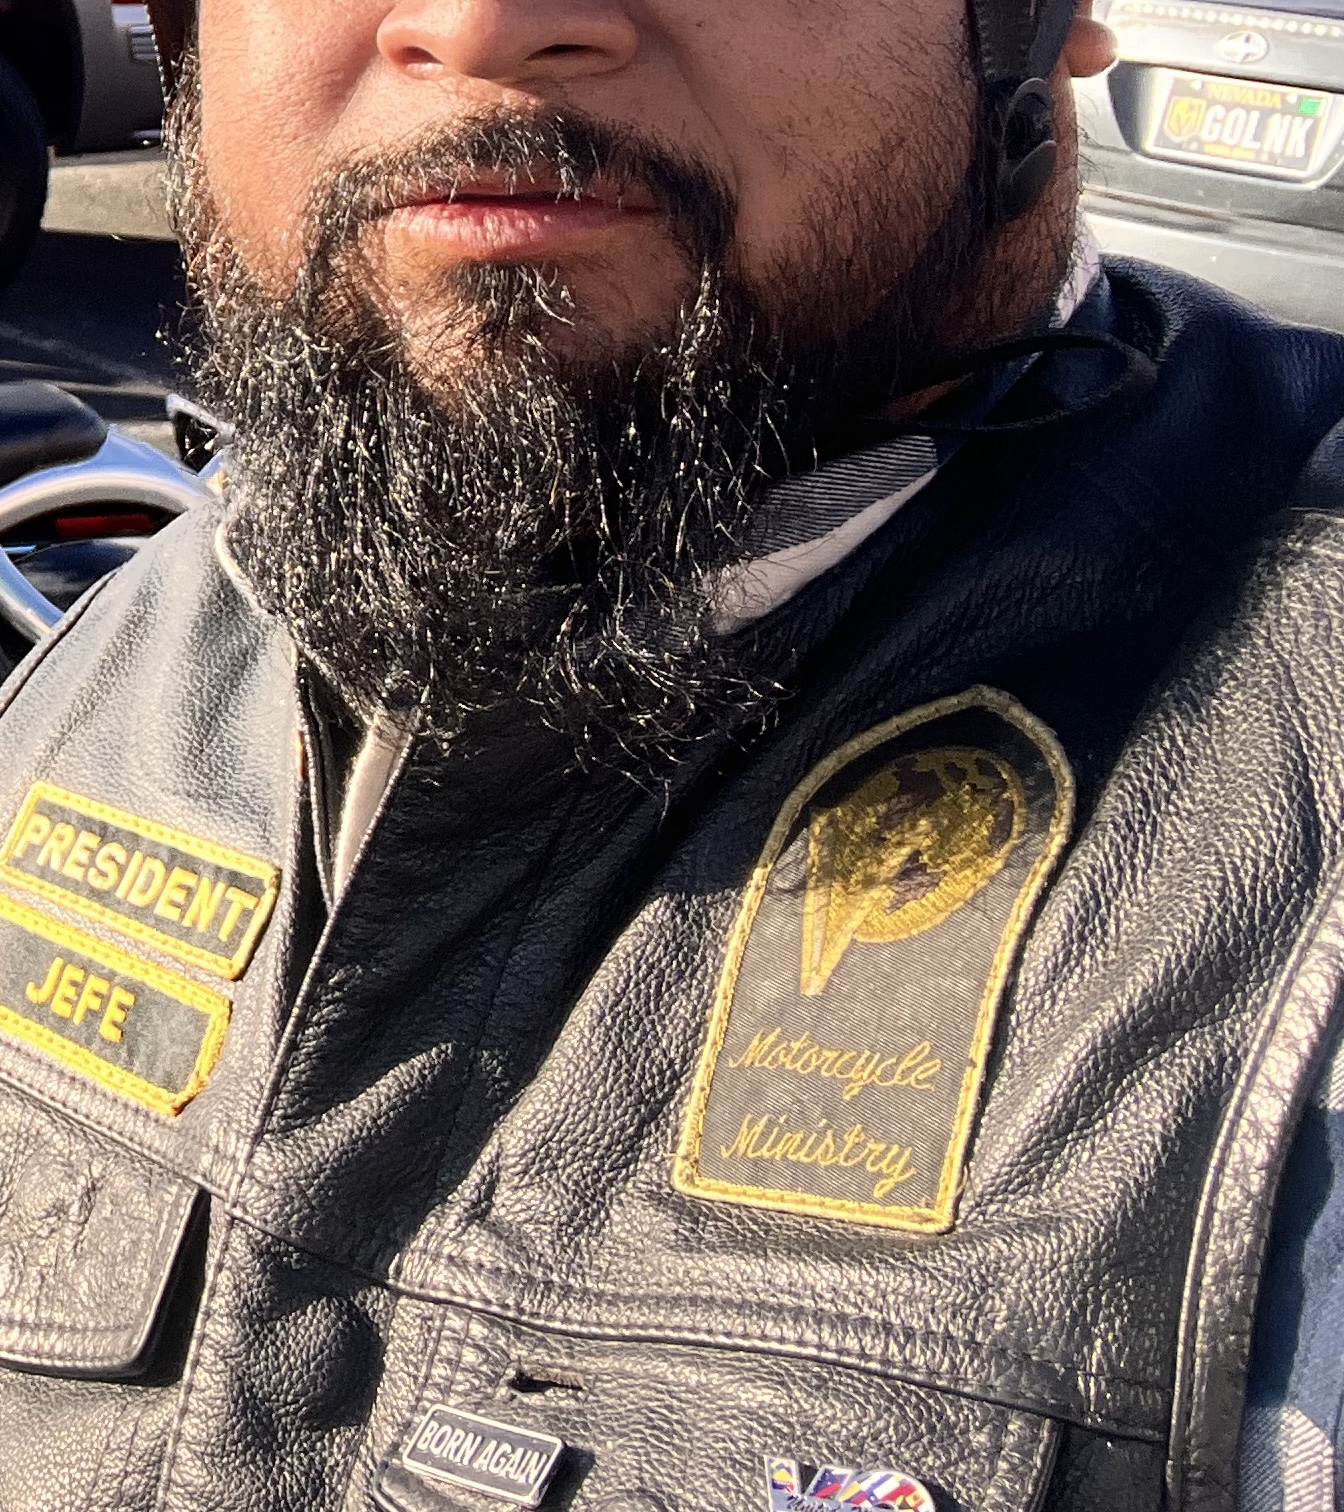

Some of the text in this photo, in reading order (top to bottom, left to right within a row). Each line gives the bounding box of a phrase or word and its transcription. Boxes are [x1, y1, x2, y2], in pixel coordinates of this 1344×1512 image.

[1207, 83, 1282, 109] NEVADA
[13, 813, 259, 943] PRESIDENT
[24, 956, 137, 1043] JEFE
[728, 1025, 941, 1101] Motorcycle
[720, 1112, 919, 1199] Ministry
[416, 1419, 548, 1485] BORN AGAIN
